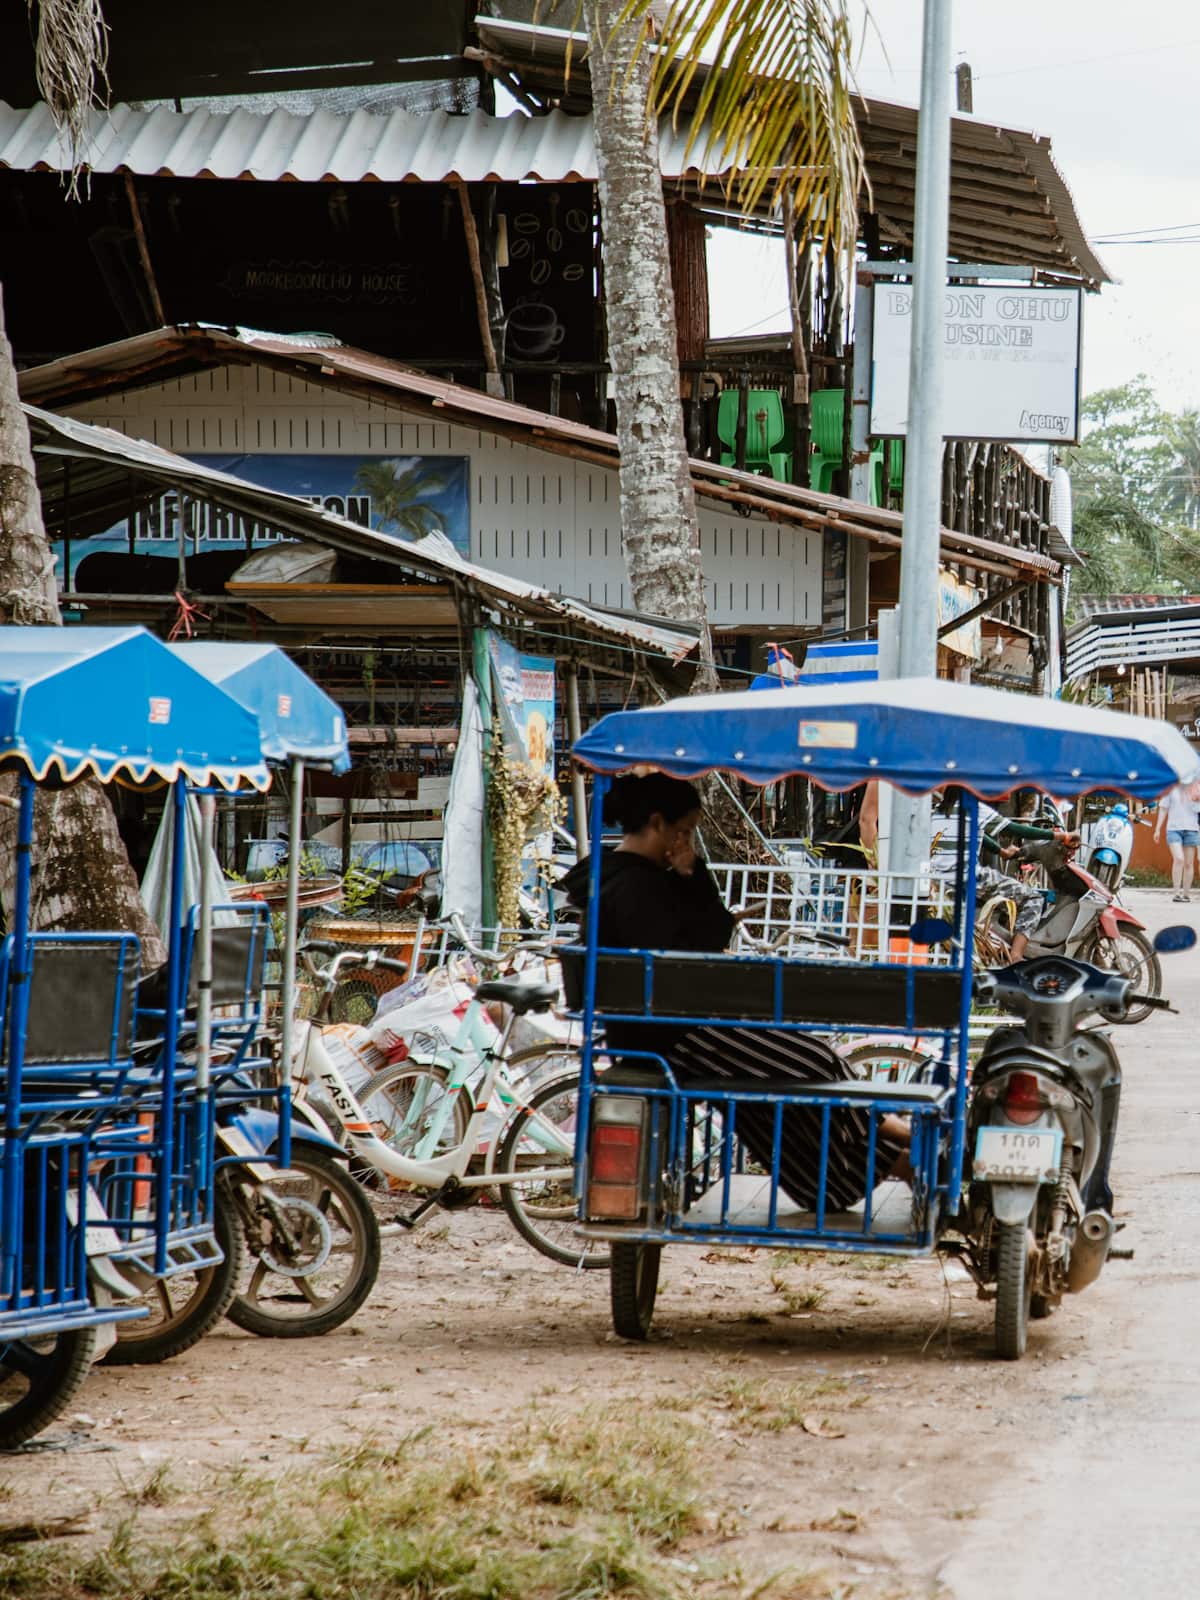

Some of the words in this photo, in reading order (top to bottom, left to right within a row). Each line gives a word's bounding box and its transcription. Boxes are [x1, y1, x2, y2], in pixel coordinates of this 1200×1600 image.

[361, 271, 406, 290] HOUSE
[996, 296, 1073, 322] CHU
[943, 323, 1033, 347] USINE
[1019, 409, 1070, 434] Agency
[320, 1073, 360, 1121] FAST
